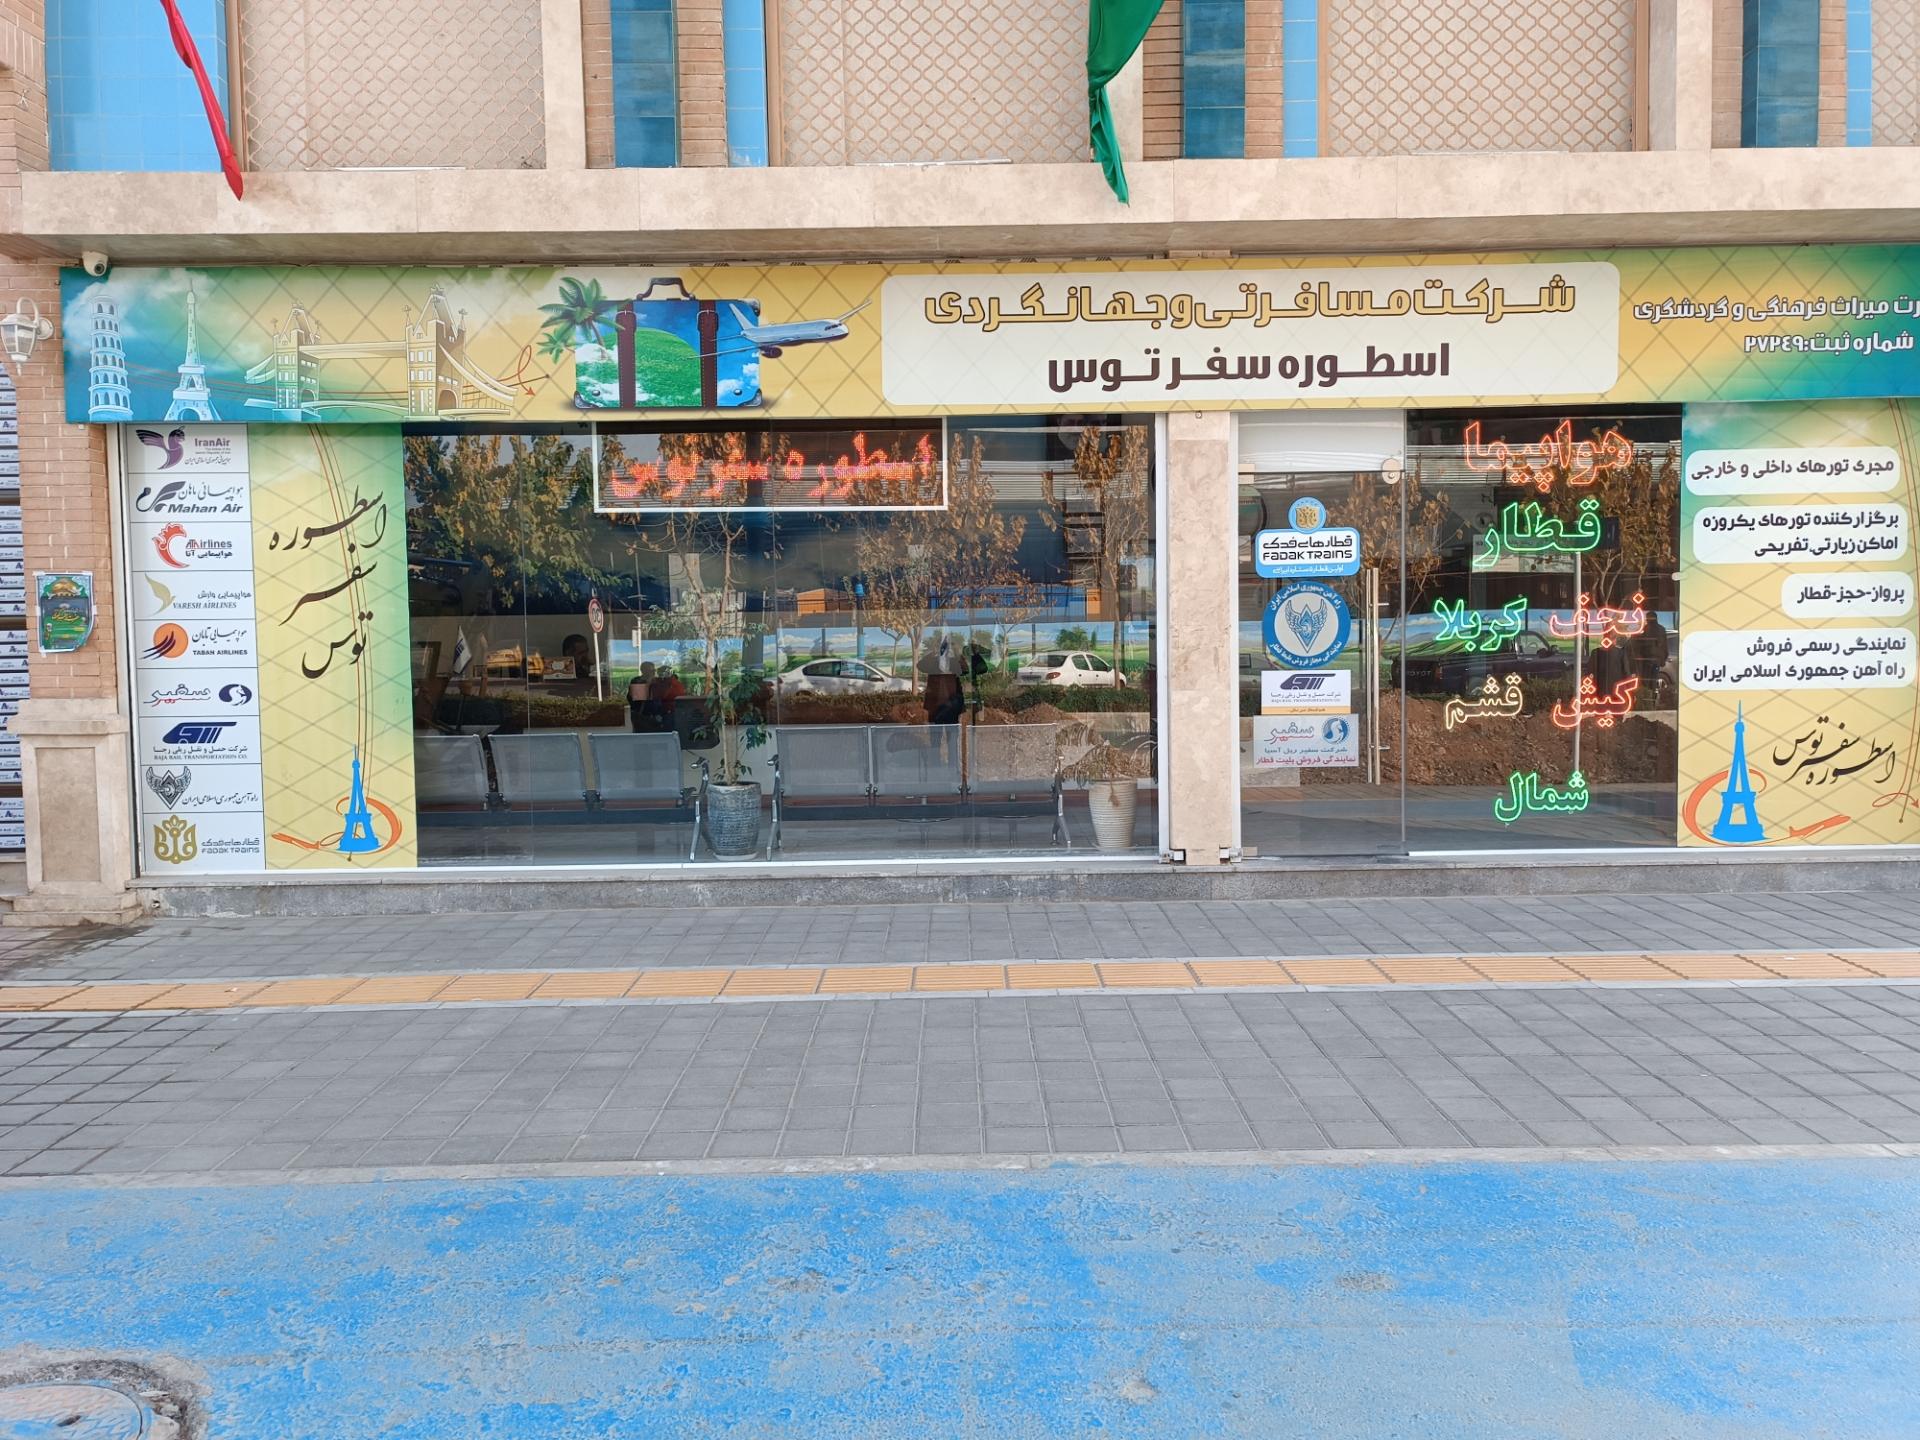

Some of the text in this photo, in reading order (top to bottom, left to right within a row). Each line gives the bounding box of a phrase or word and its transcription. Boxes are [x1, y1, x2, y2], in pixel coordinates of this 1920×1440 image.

[924, 274, 1576, 332] شرکت مسافرتی و جهانگردی
[1633, 296, 1729, 323] گردشگری
[1732, 302, 1745, 321] و
[1747, 295, 1824, 321] فرهنگی
[1830, 297, 1889, 320] میراث
[1852, 331, 1914, 355] شماره
[1048, 342, 1450, 393] اسطوره سفر توس
[194, 437, 231, 447] IranAir
[1465, 419, 1632, 492] هواپیما
[1691, 459, 1894, 480] مجری تورهای داخلی و خارجی
[168, 504, 244, 513] Mahan Air
[269, 484, 387, 551] اسطوره
[1472, 499, 1601, 567] قطار
[1703, 514, 1756, 531] یکروزه
[1758, 512, 1811, 530] تورهای
[1262, 536, 1297, 549] فدک
[1857, 536, 1898, 553] اماکن
[278, 542, 378, 626] سفر
[203, 601, 237, 609] AIRLINES
[1434, 592, 1645, 652] نجف کربلا
[301, 610, 374, 679] توس
[1747, 636, 1907, 656] نمایندگی رسمی فروش
[1693, 660, 1906, 683] راه آهن جمهوری اسلامی ایران
[1446, 675, 1639, 730] کیش قشم
[228, 745, 248, 753] شرکت
[1772, 716, 1896, 785] اسطوره سفر توس
[1495, 770, 1589, 823] شمال
